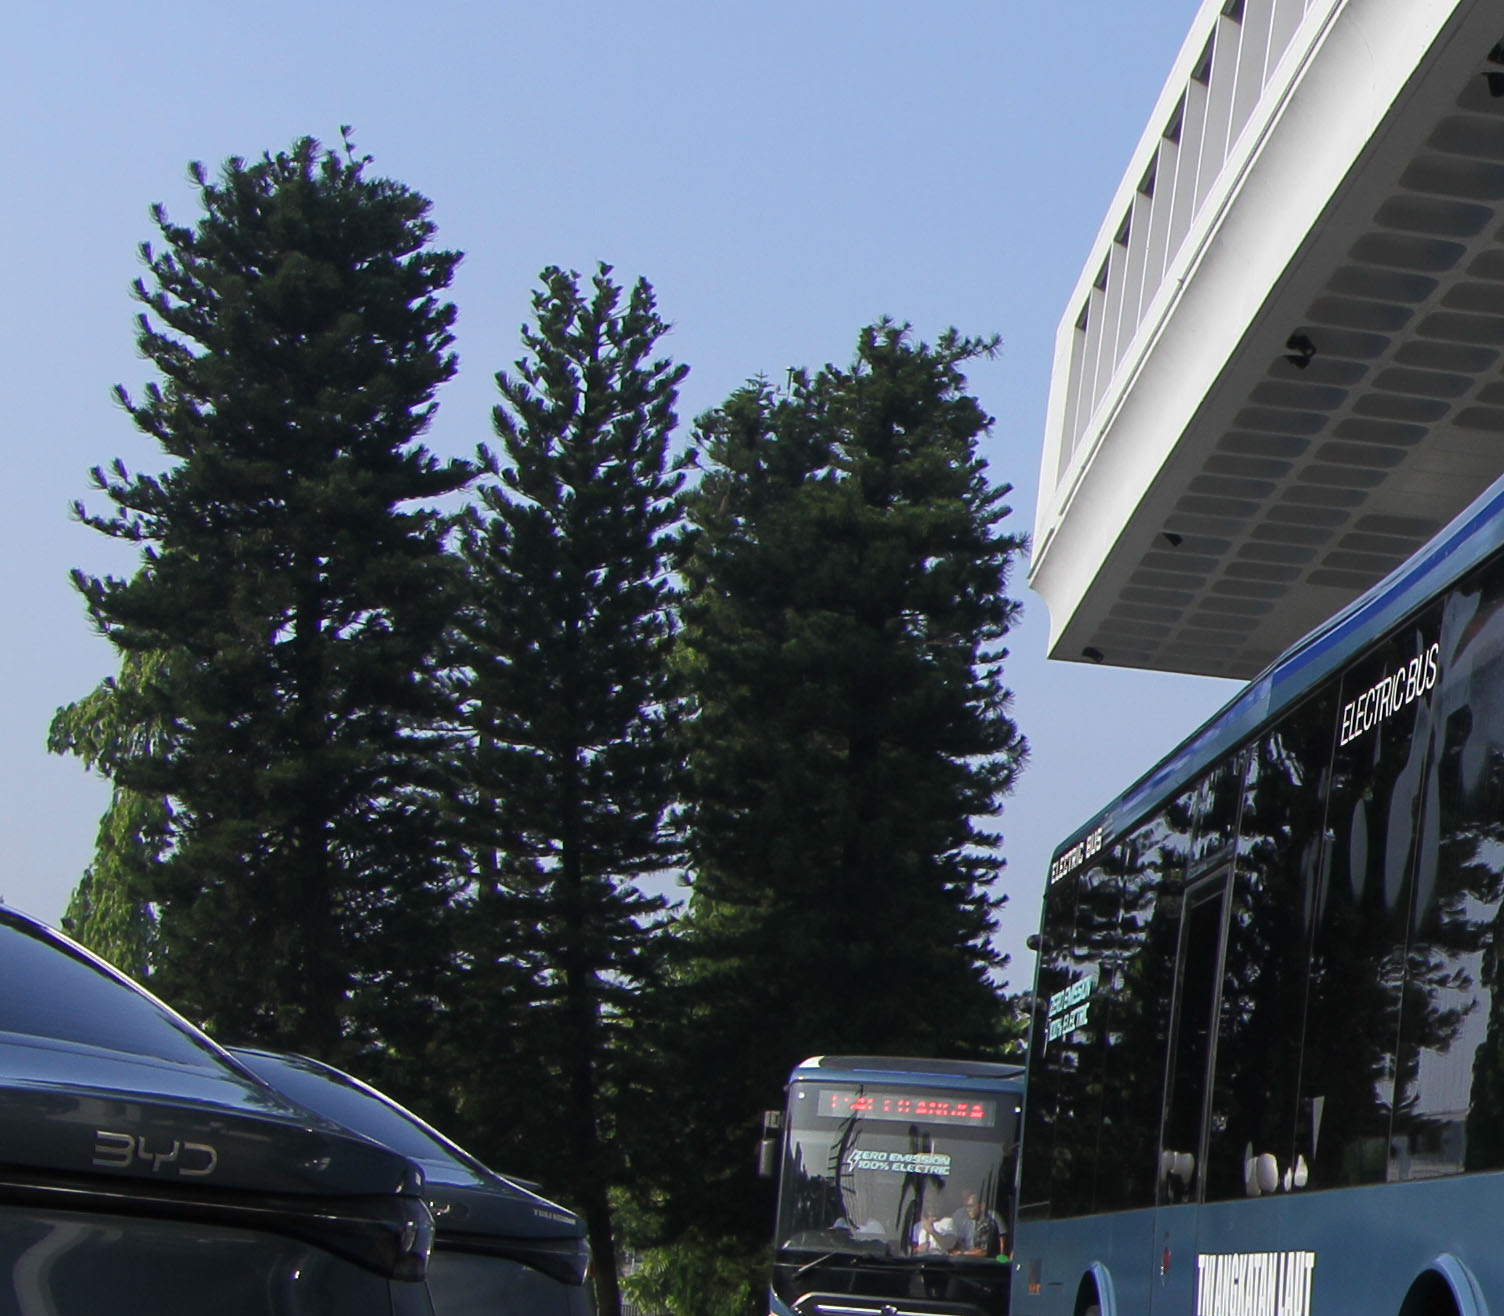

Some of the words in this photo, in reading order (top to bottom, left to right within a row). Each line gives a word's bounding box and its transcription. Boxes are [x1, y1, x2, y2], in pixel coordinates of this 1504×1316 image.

[1341, 667, 1407, 746] ELECTRIC
[1405, 643, 1440, 704] BUS
[1051, 842, 1084, 885] ELECTRIC
[1085, 828, 1103, 859] BUS
[92, 1130, 217, 1176] BYD
[854, 1150, 886, 1161] ZERO
[888, 1153, 952, 1166] EMISSION
[856, 1161, 889, 1172] 100%
[890, 1162, 951, 1176] ELECTRIC
